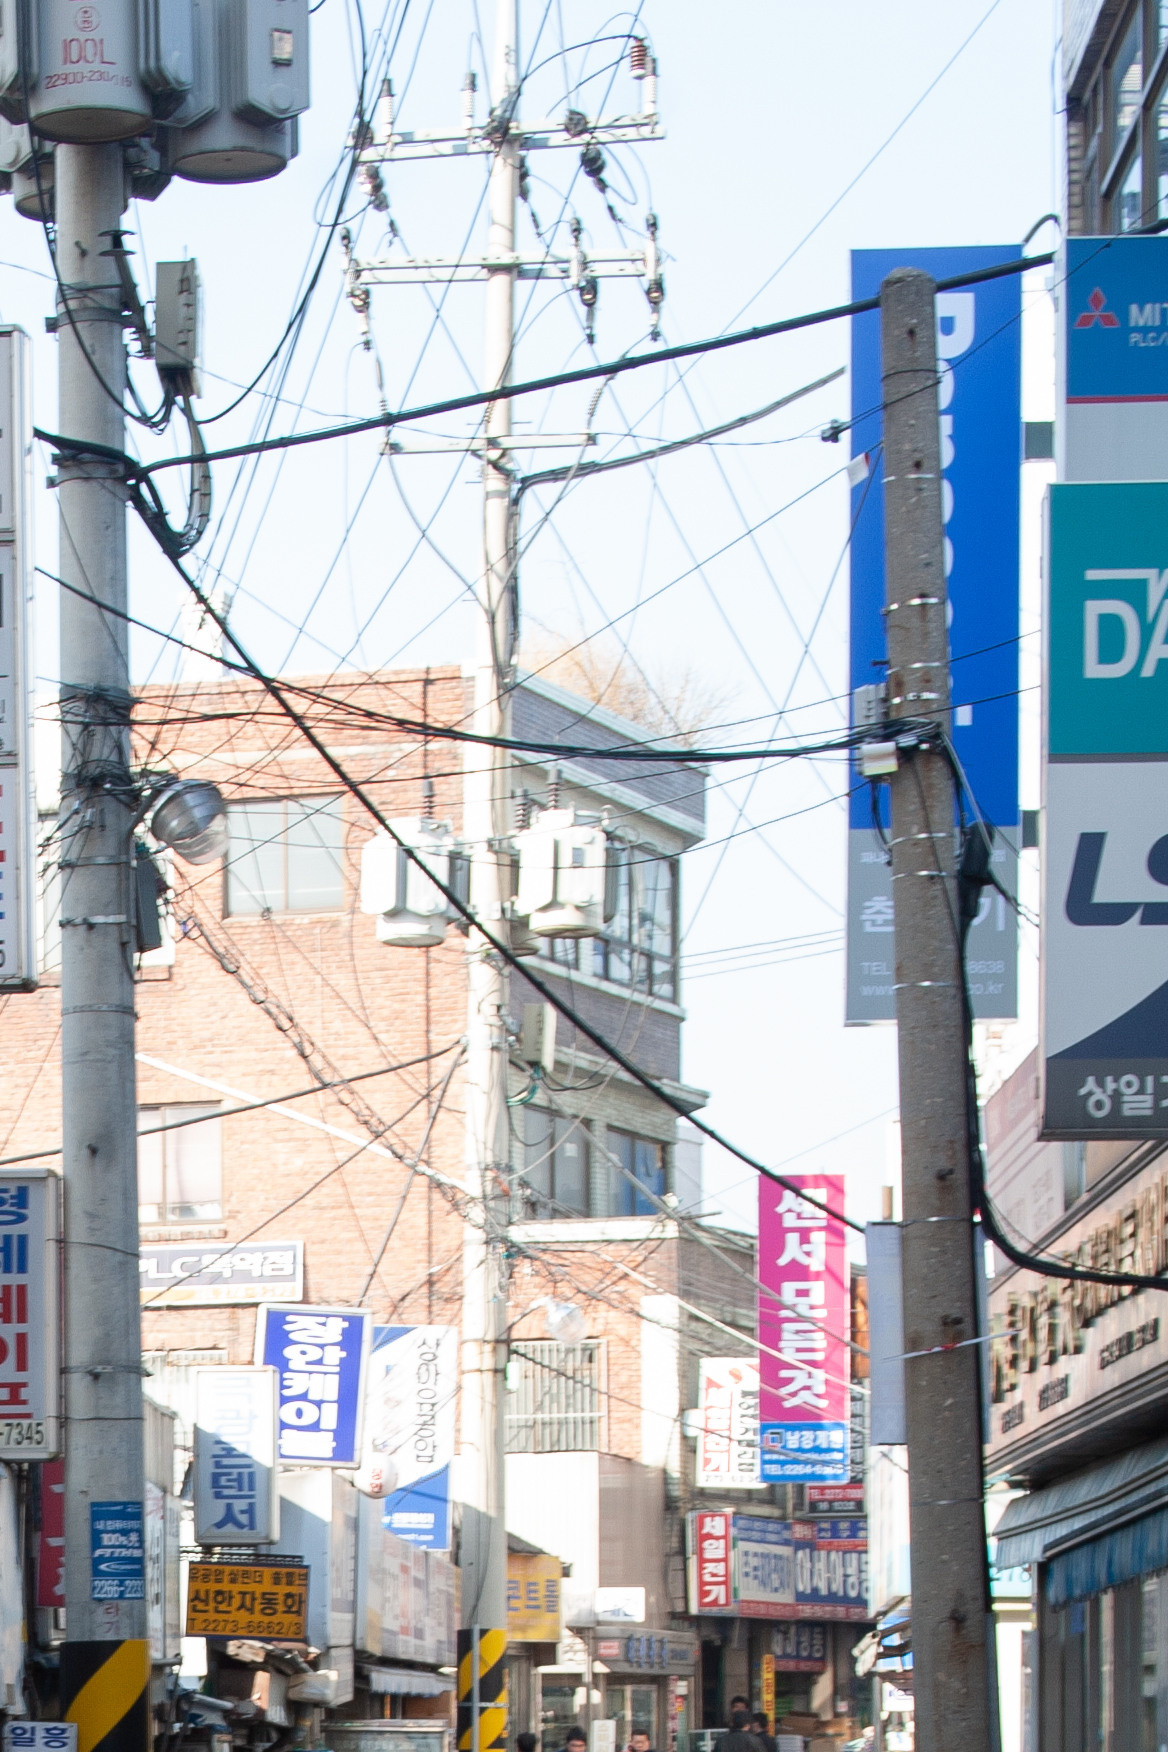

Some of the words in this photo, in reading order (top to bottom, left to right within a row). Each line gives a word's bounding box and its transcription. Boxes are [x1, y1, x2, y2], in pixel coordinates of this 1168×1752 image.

[775, 1189, 828, 1271] 센서
[279, 1315, 350, 1458] 장안케이블
[778, 1281, 830, 1408] 모든것
[191, 1589, 306, 1616] 신한자동화
[701, 1516, 727, 1604] 세일전기
